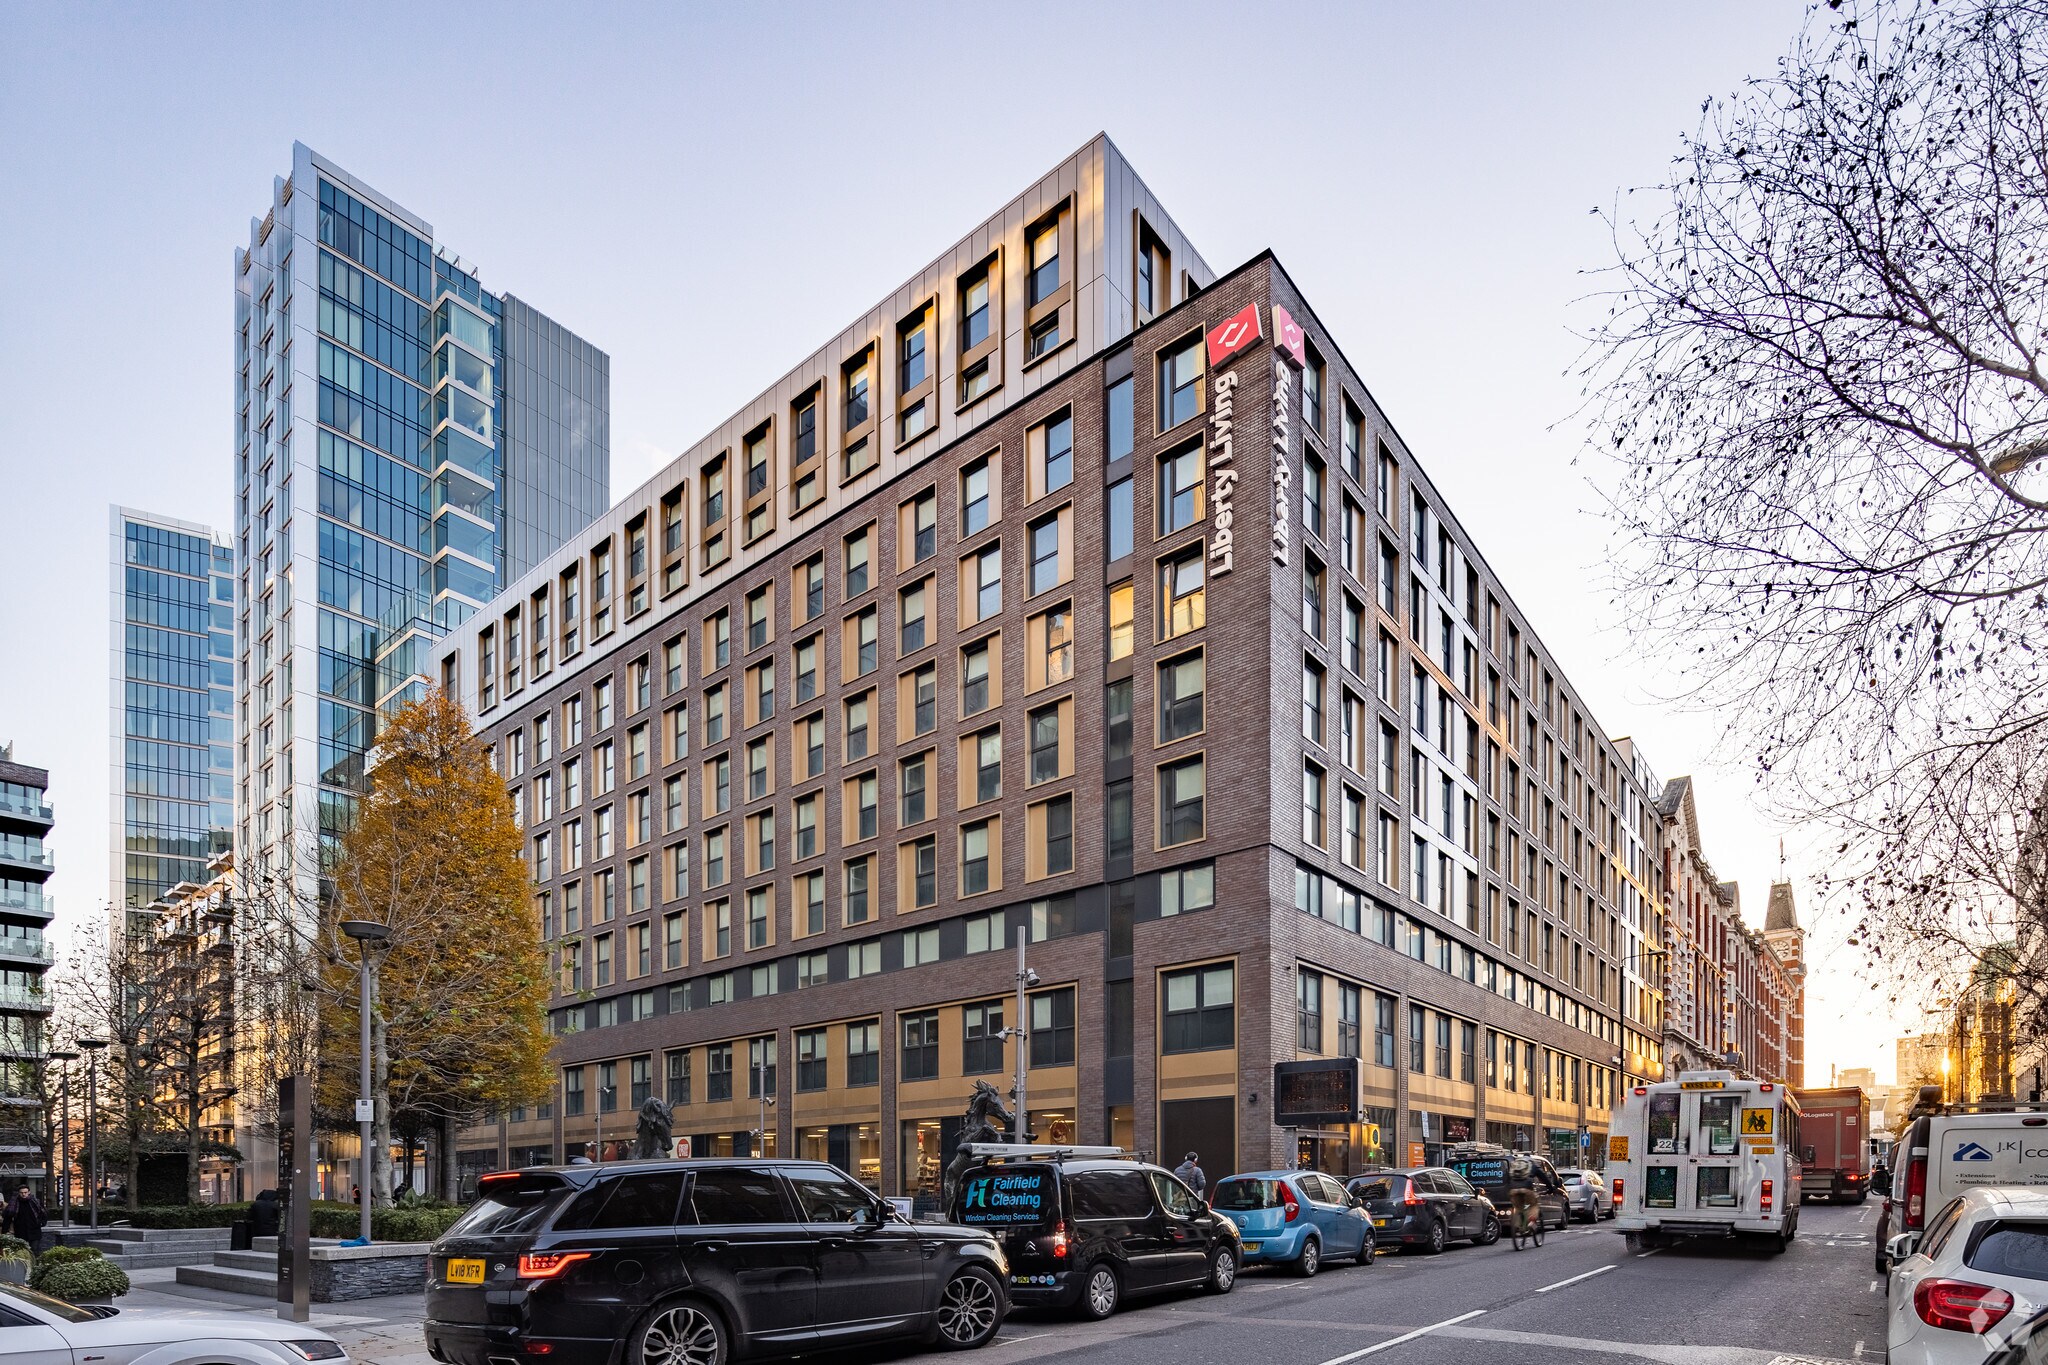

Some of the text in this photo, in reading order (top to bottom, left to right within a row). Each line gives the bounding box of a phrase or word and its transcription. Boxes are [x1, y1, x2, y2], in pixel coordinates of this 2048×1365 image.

[1209, 370, 1238, 578] Liberty Living
[1659, 1140, 1672, 1149] 22
[1996, 1142, 2016, 1153] J.K
[1471, 1161, 1501, 1169] Fairfield
[993, 1176, 1040, 1190] Fairfield
[991, 1193, 1040, 1208] Cleaning
[987, 1213, 1011, 1222] Cleaning
[1013, 1212, 1040, 1220] Services
[450, 1264, 480, 1278] LV18 XFR
